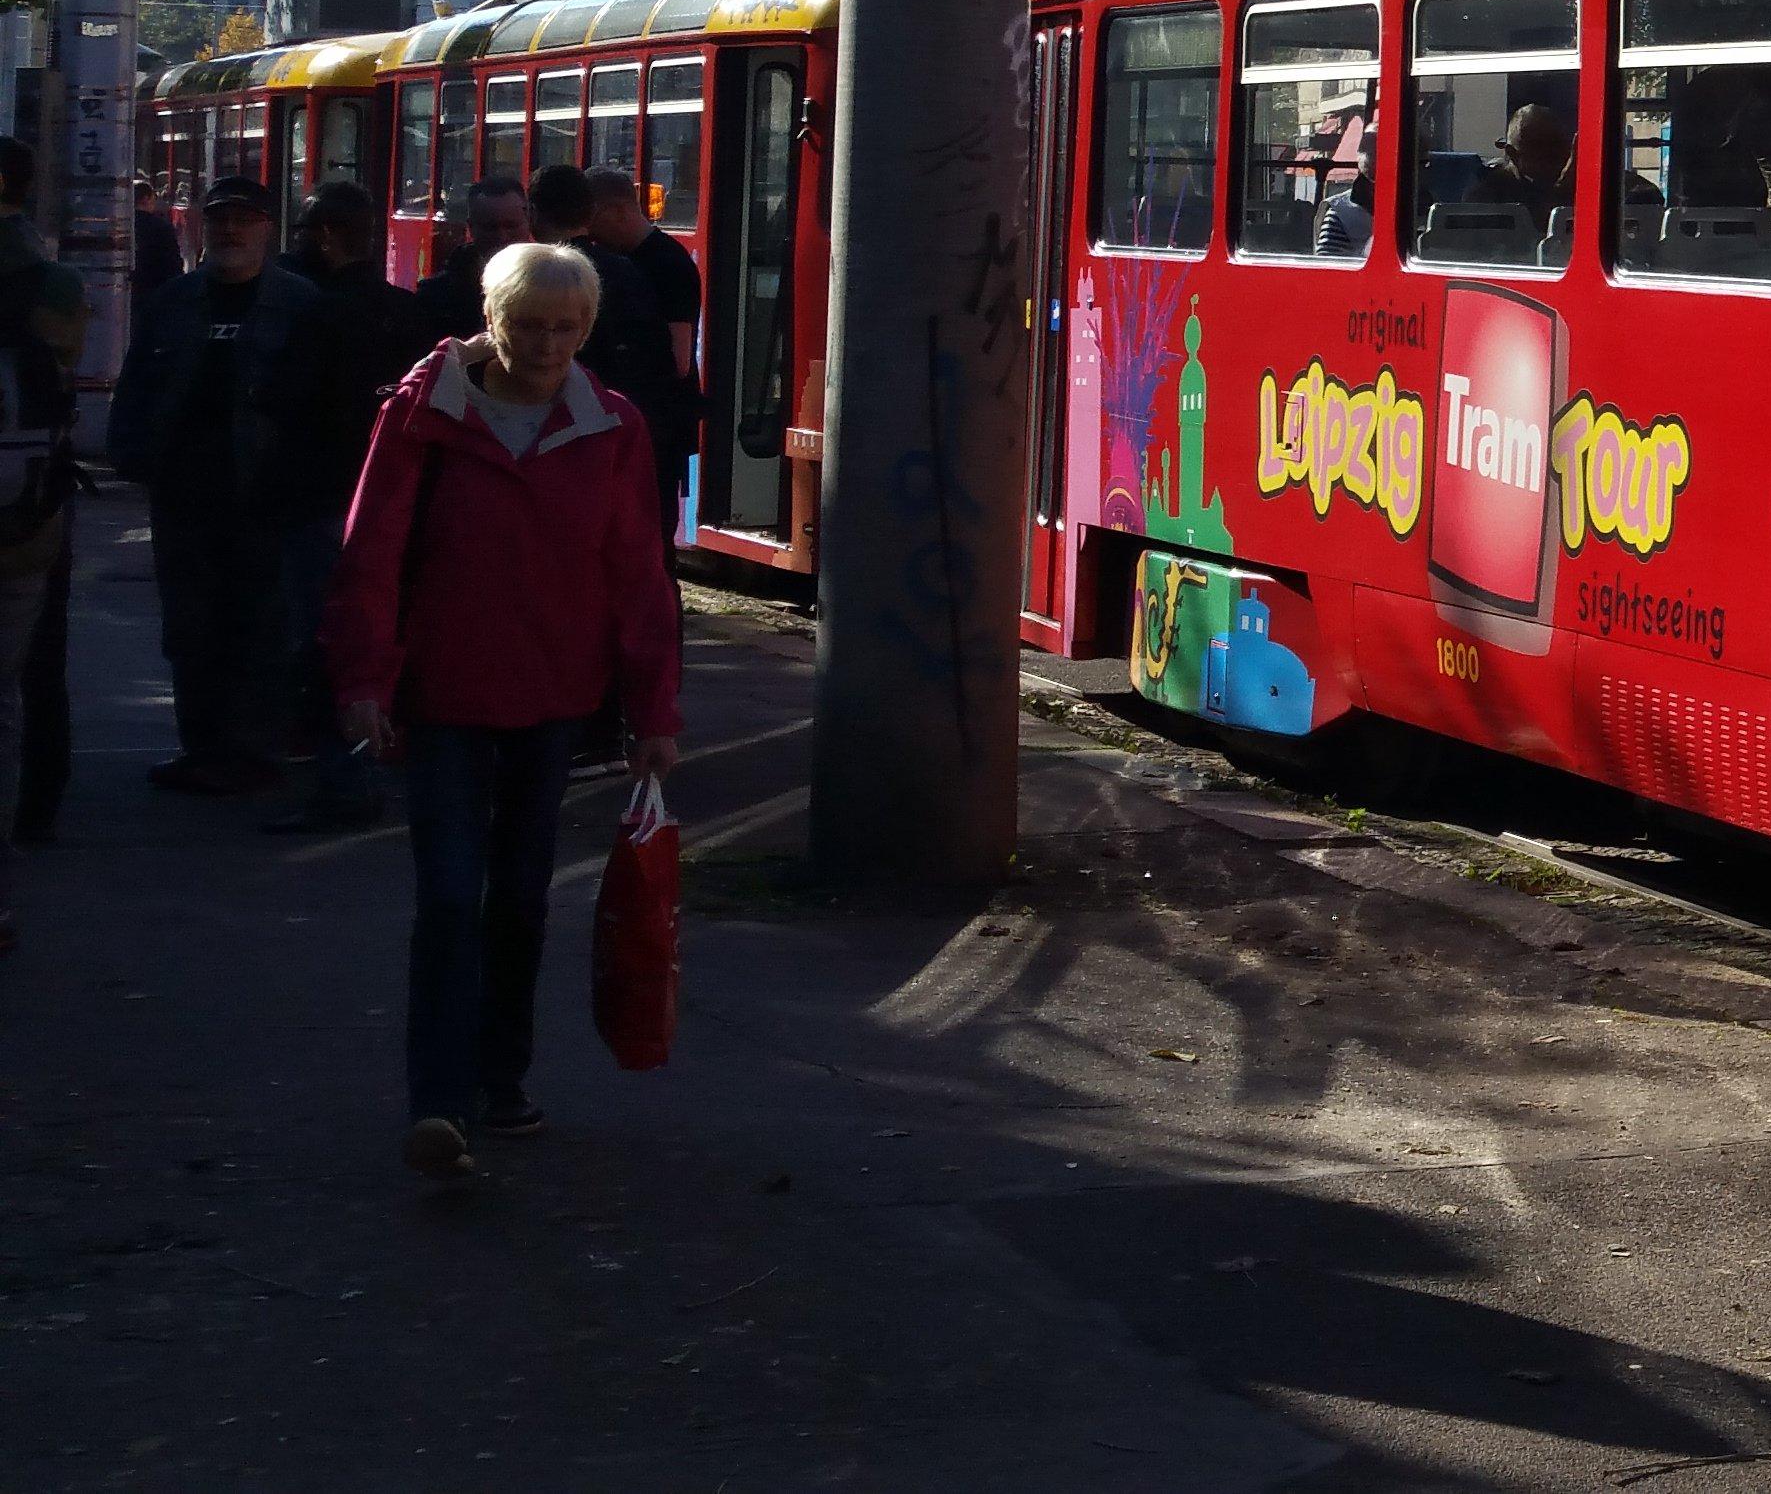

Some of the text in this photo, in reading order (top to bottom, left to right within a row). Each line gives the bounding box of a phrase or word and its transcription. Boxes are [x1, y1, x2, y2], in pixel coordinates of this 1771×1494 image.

[1347, 301, 1426, 354] original
[1258, 357, 1692, 558] Leipzig Tram Tour
[1578, 570, 1726, 661] sightseeing
[1436, 636, 1480, 684] 1800
